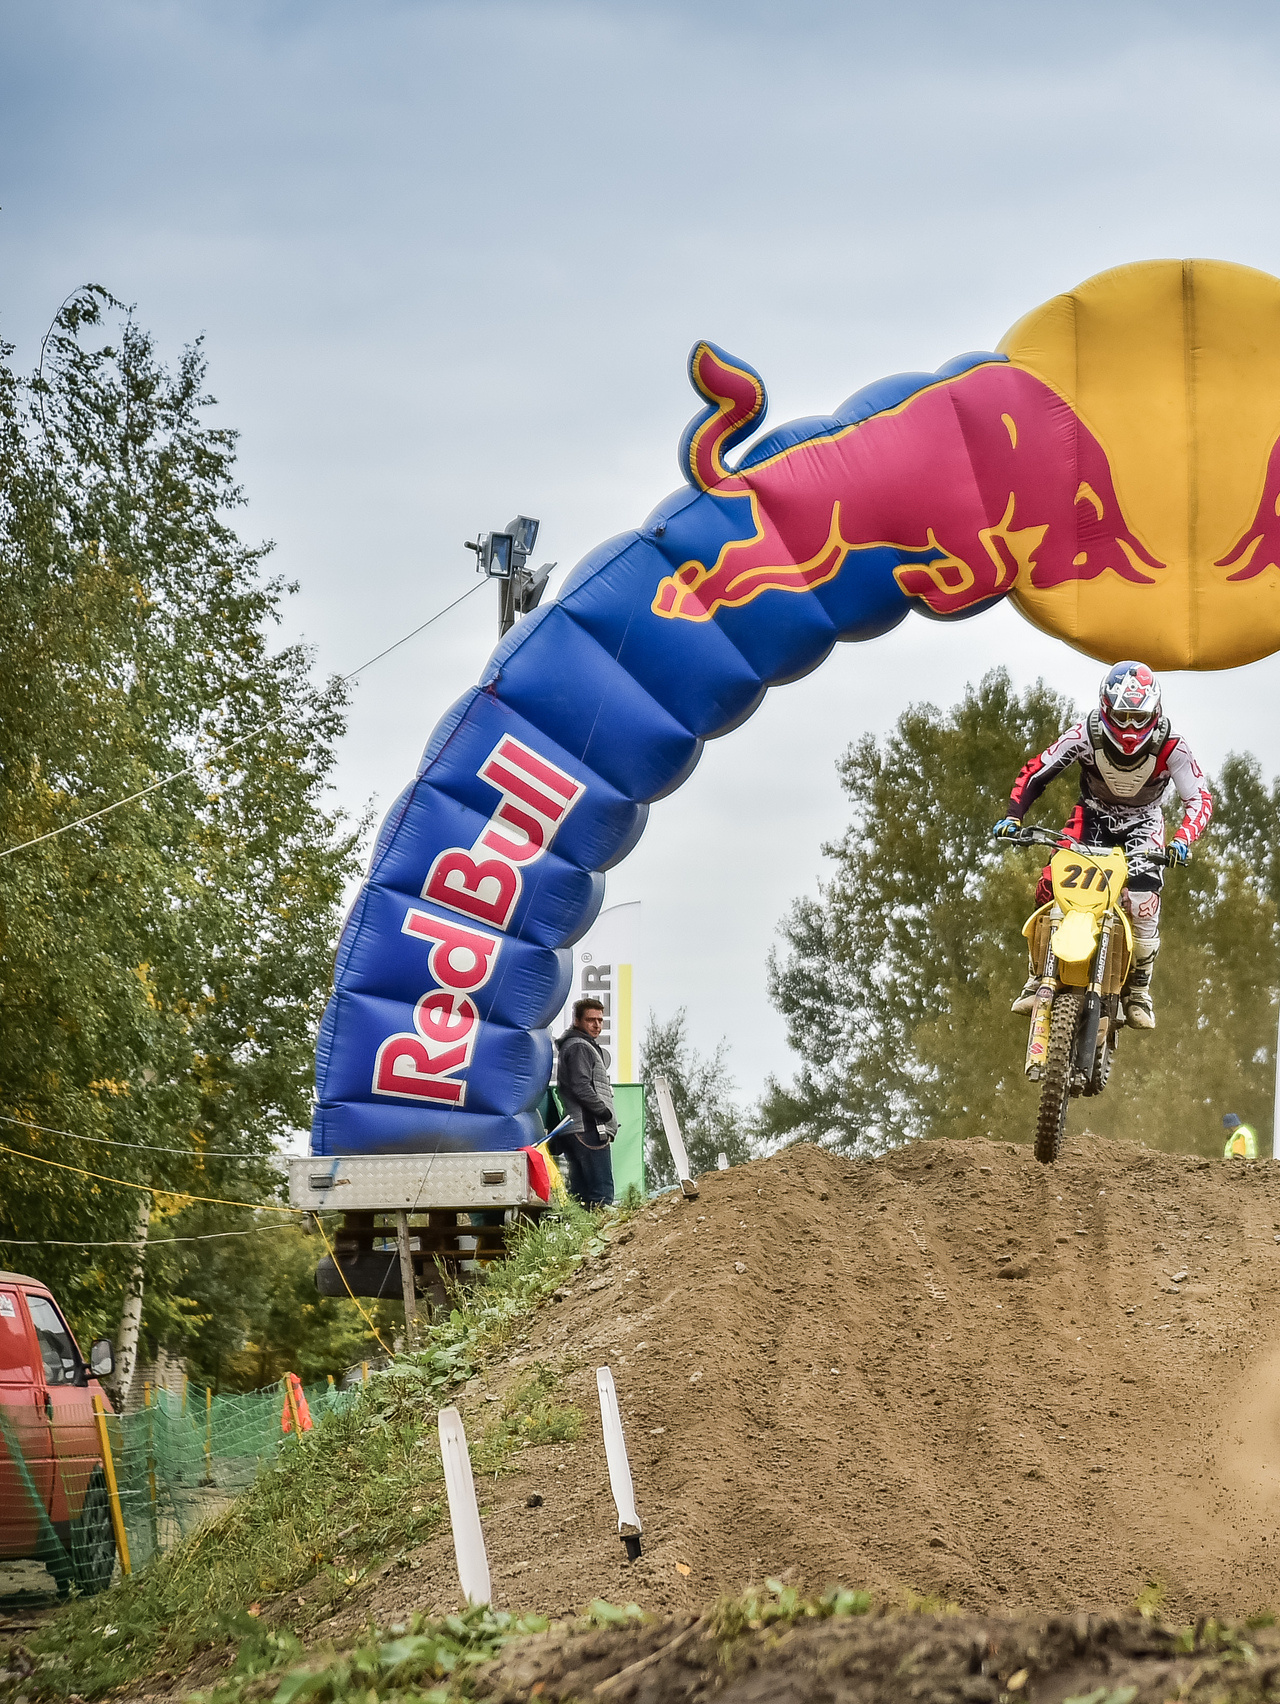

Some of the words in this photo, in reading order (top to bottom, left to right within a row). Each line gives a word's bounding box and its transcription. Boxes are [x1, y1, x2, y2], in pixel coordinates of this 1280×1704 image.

[420, 732, 587, 931] Bull
[1059, 864, 1114, 893] 211
[372, 908, 503, 1107] Red
